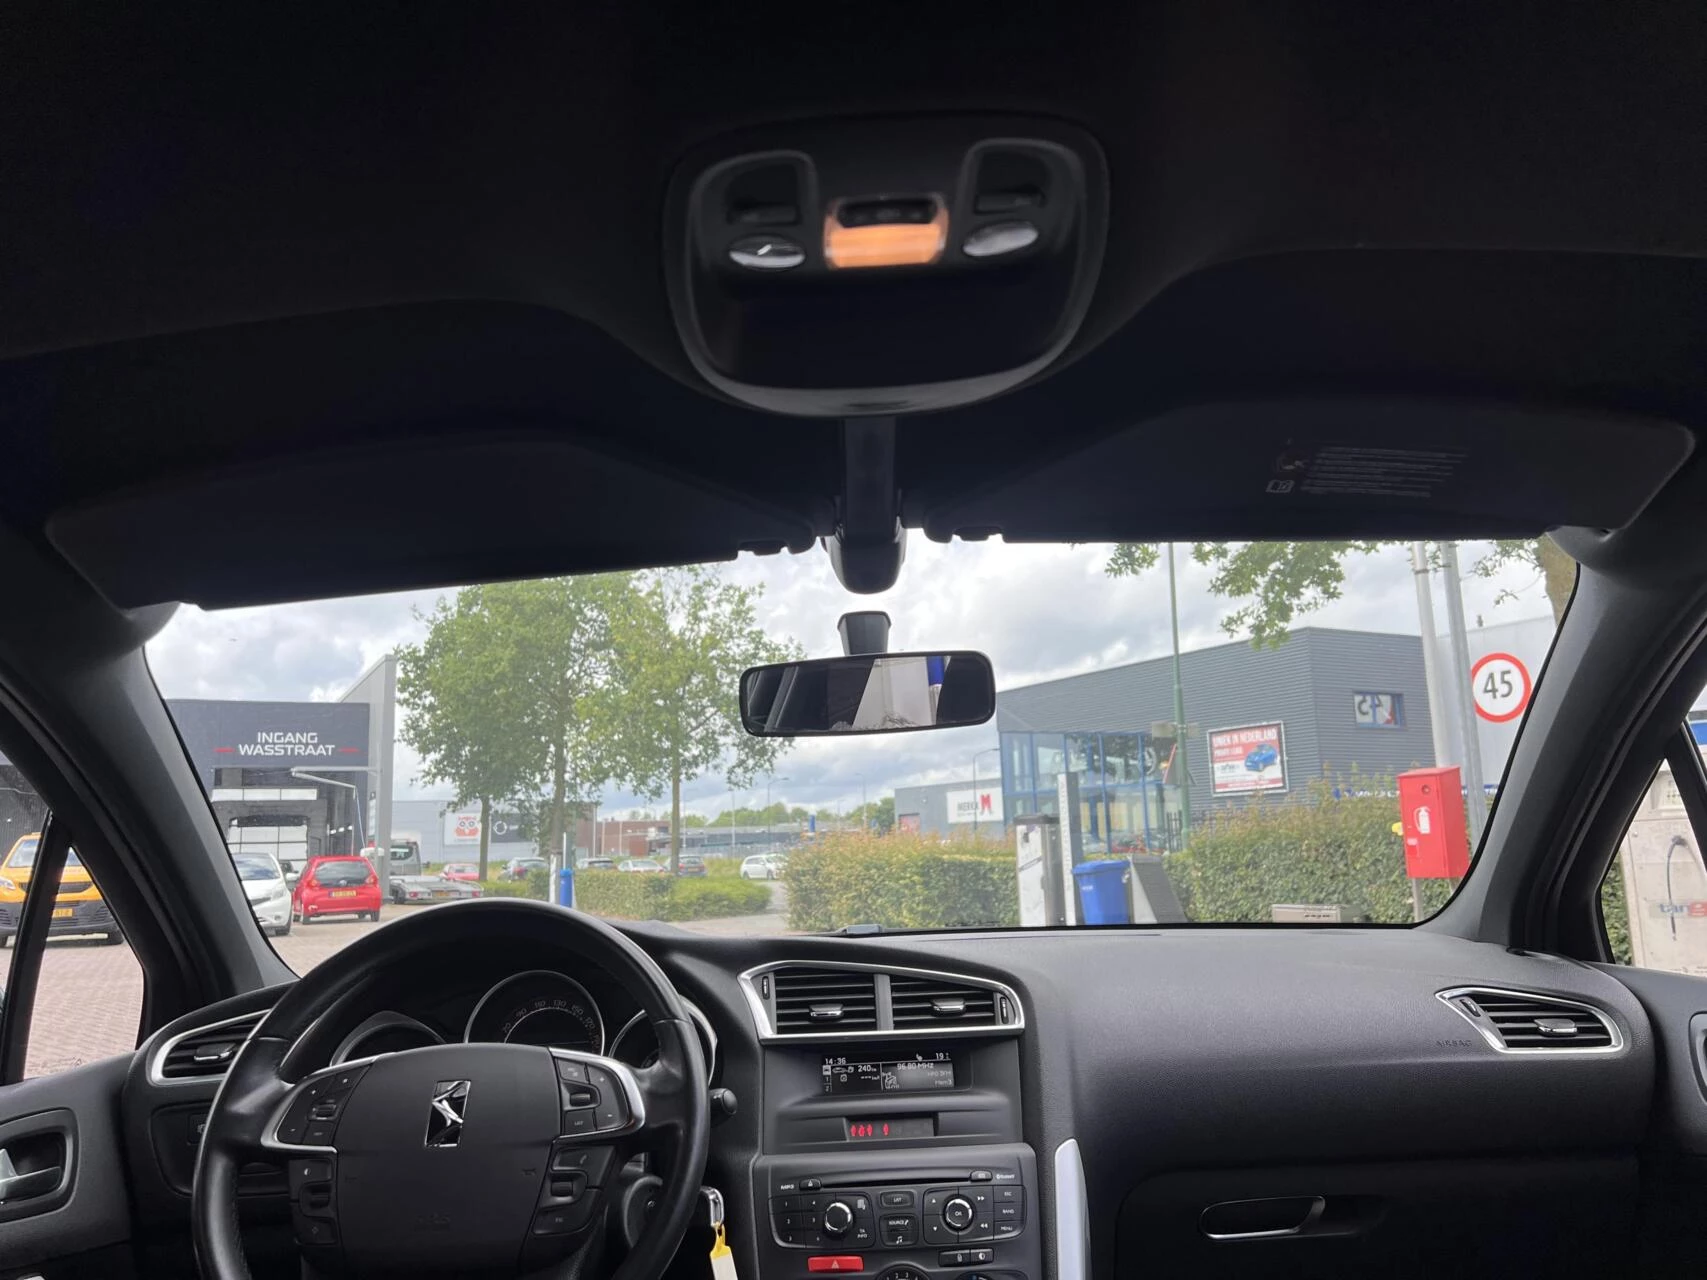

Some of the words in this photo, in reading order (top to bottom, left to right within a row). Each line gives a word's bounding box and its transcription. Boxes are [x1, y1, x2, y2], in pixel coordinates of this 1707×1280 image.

[1482, 669, 1513, 700] 45
[257, 731, 319, 744] INGANG
[238, 743, 336, 756] WASSTRAAT
[553, 999, 567, 1008] 130
[825, 1057, 847, 1065] 14:36
[858, 1065, 871, 1073] 240
